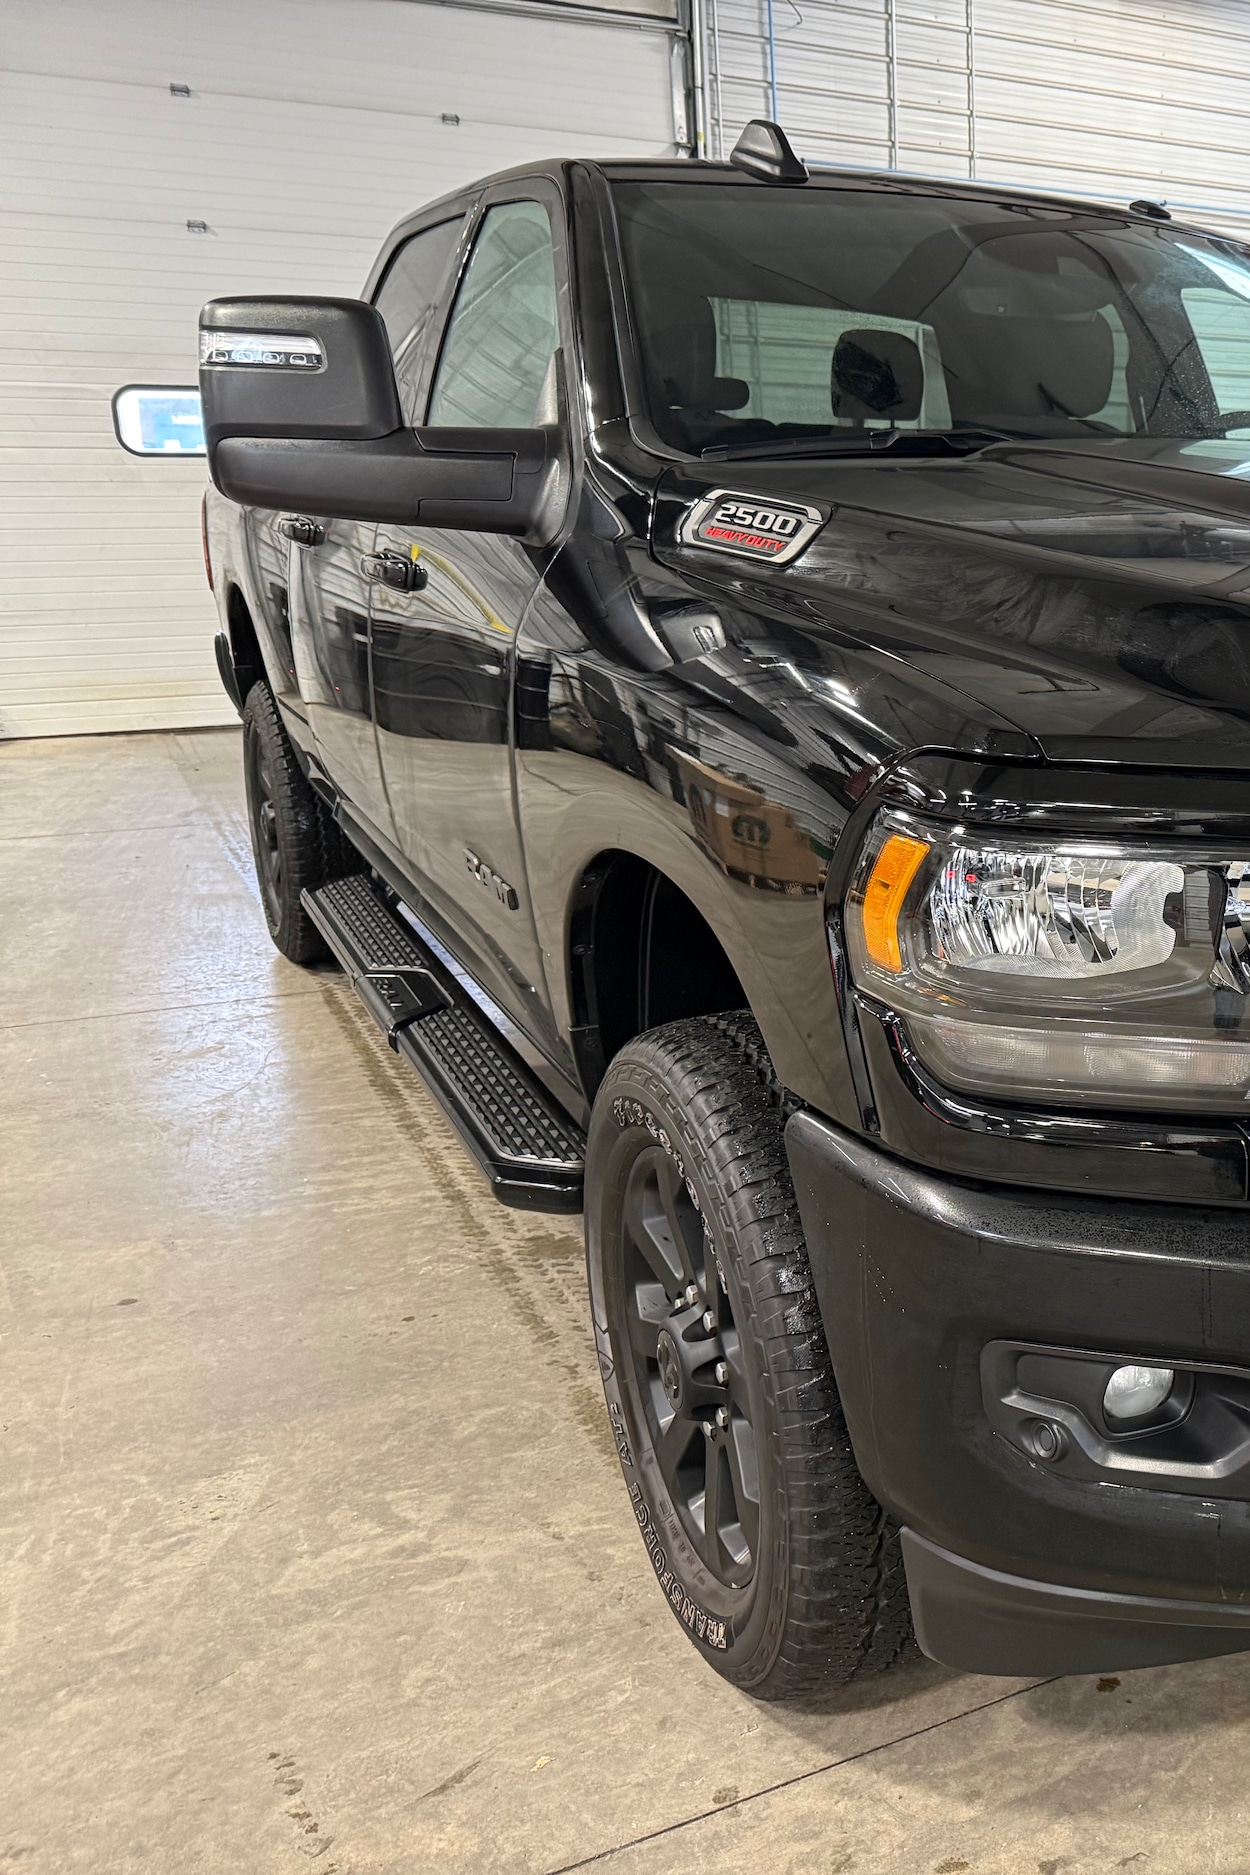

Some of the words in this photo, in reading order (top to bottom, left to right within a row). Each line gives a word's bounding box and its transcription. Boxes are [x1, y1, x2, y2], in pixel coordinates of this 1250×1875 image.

[714, 503, 799, 535] 2500
[705, 526, 749, 545] HEAVY
[745, 535, 787, 552] DUTY
[628, 1480, 728, 1650] TRANSFORCE
